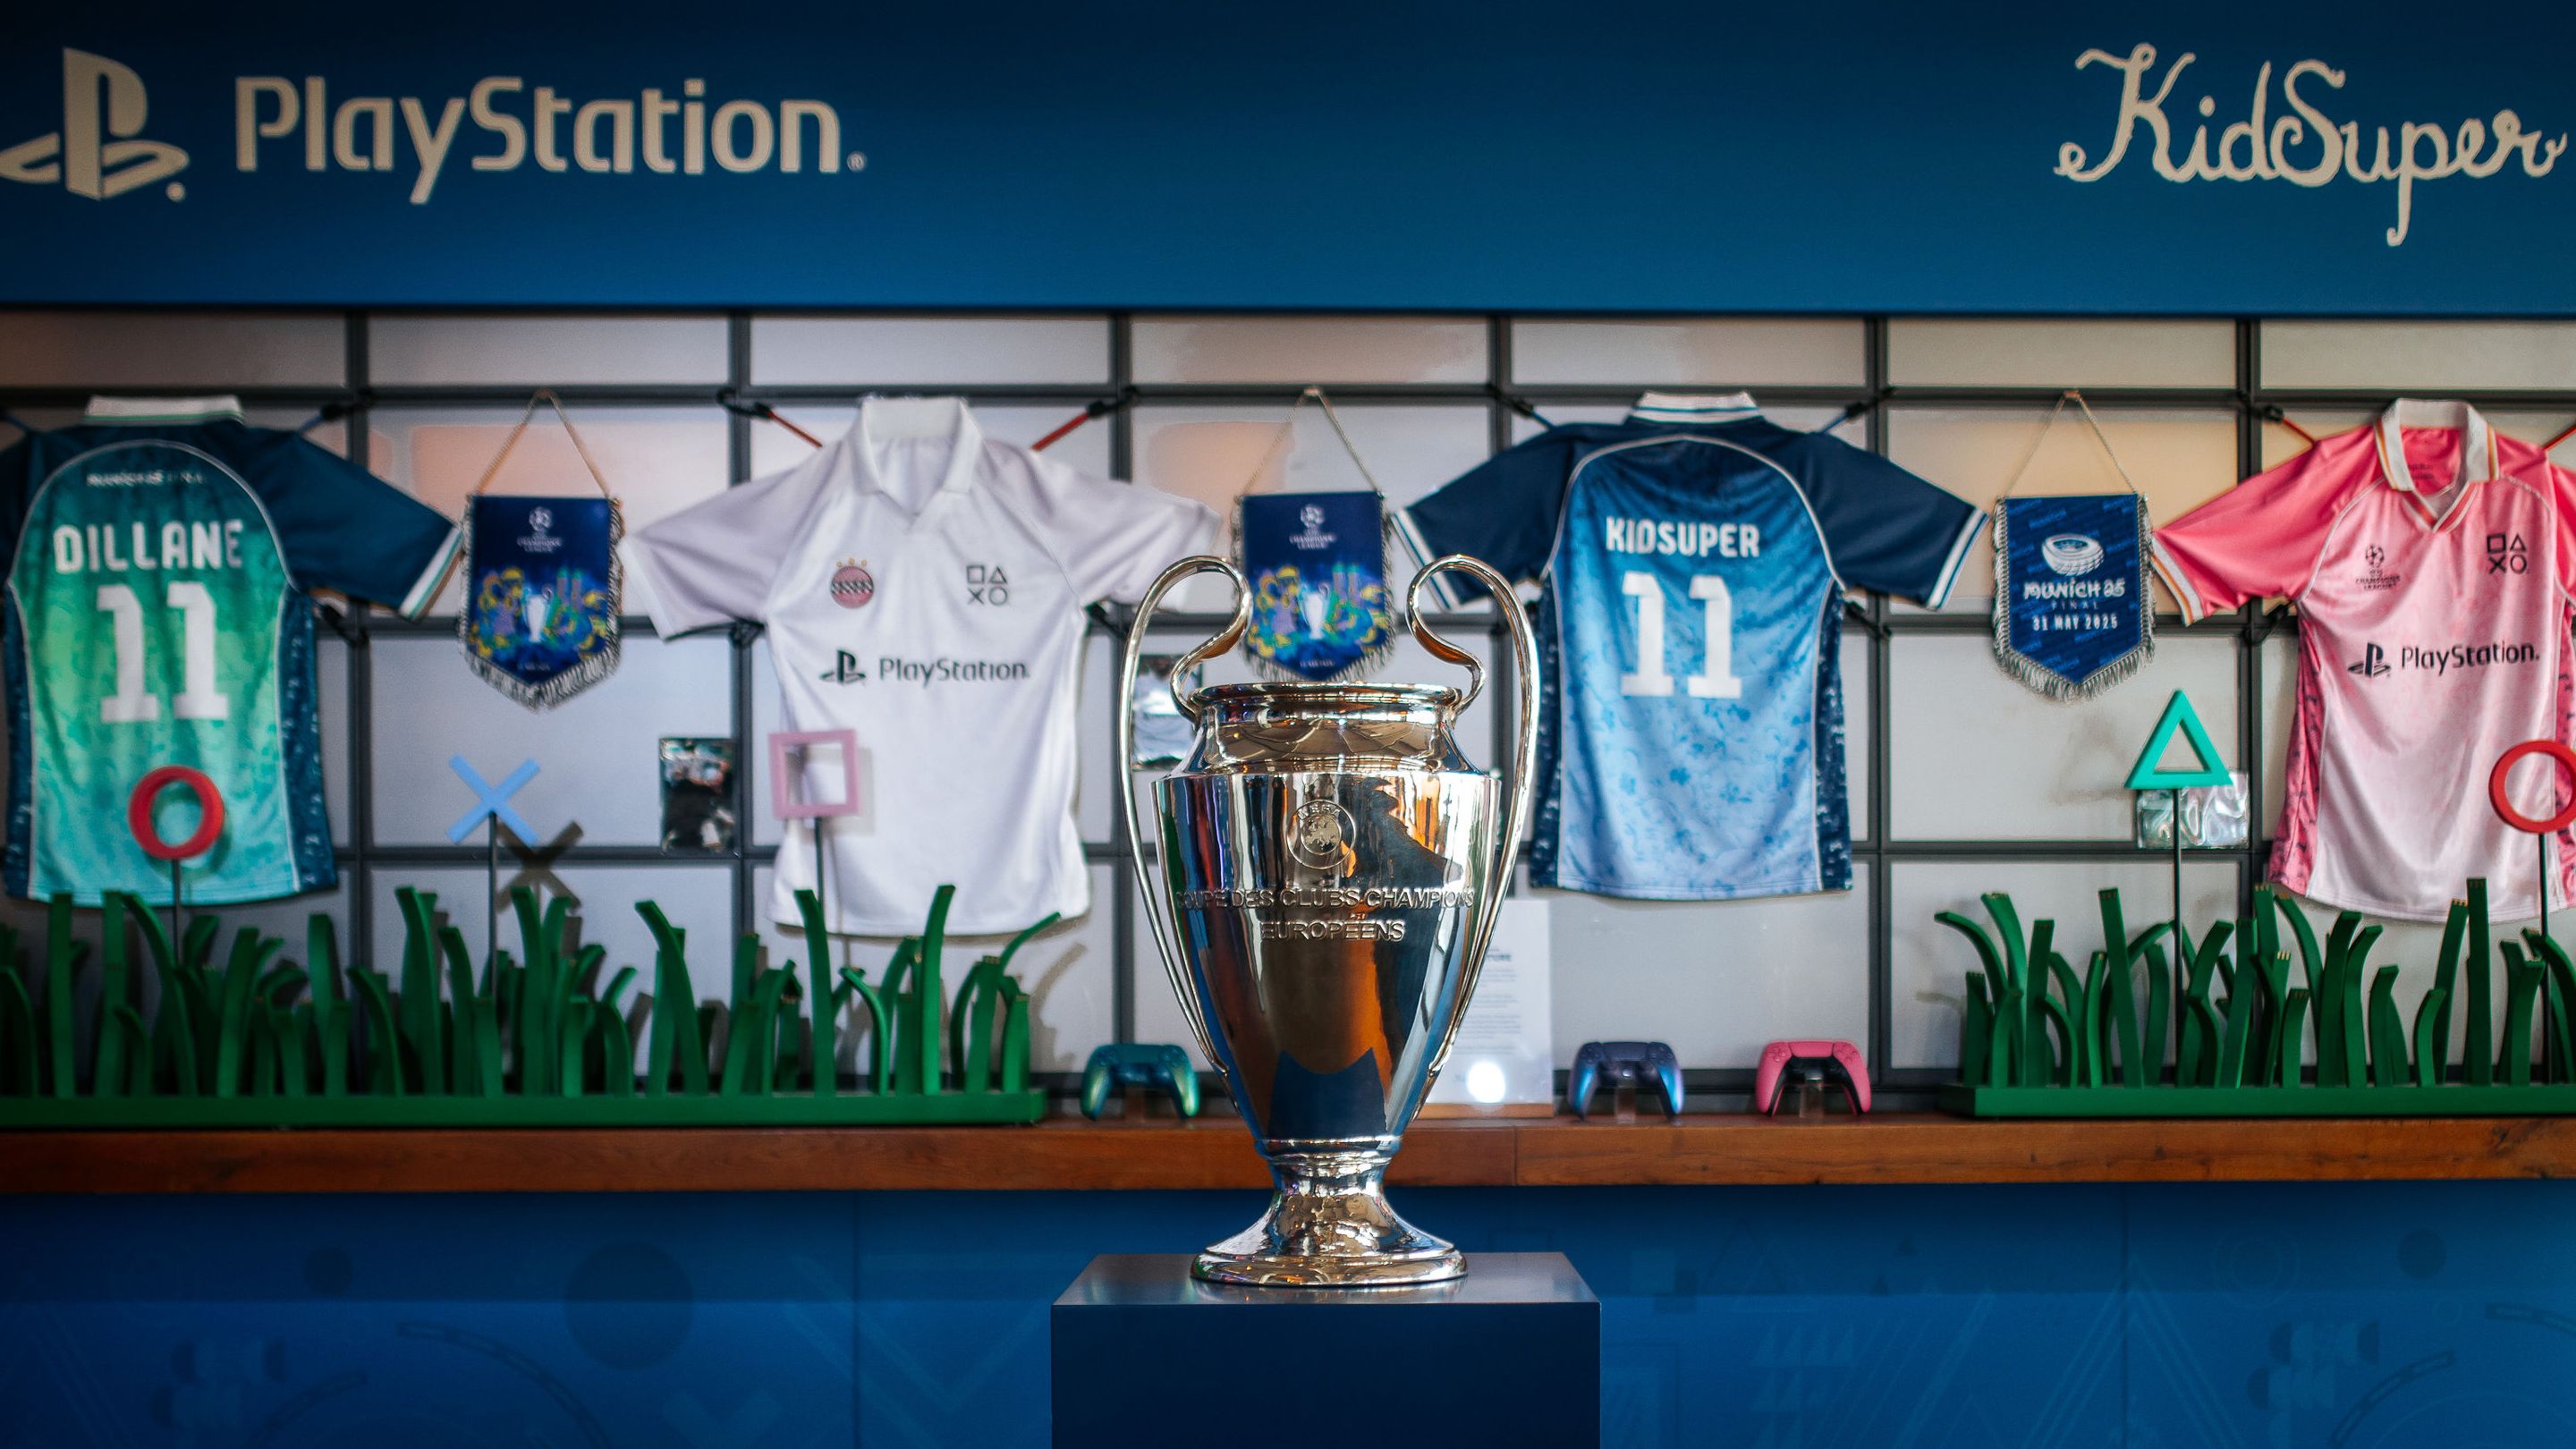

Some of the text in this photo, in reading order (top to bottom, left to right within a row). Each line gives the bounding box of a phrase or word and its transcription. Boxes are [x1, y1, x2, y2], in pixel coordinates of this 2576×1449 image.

[2053, 43, 2567, 247] KidSuper
[53, 519, 244, 574] DILLANE
[1606, 515, 1761, 558] KIDSUPER
[2051, 600, 2098, 610] FINAL
[2103, 578, 2126, 597] 25
[1620, 570, 1742, 699] 11
[2032, 613, 2118, 631] 31 MAY 2025
[96, 580, 231, 724] 11
[1232, 888, 1275, 908] DES
[1280, 887, 1361, 908] CLUBS
[1364, 885, 1476, 910] CHAMPIONS
